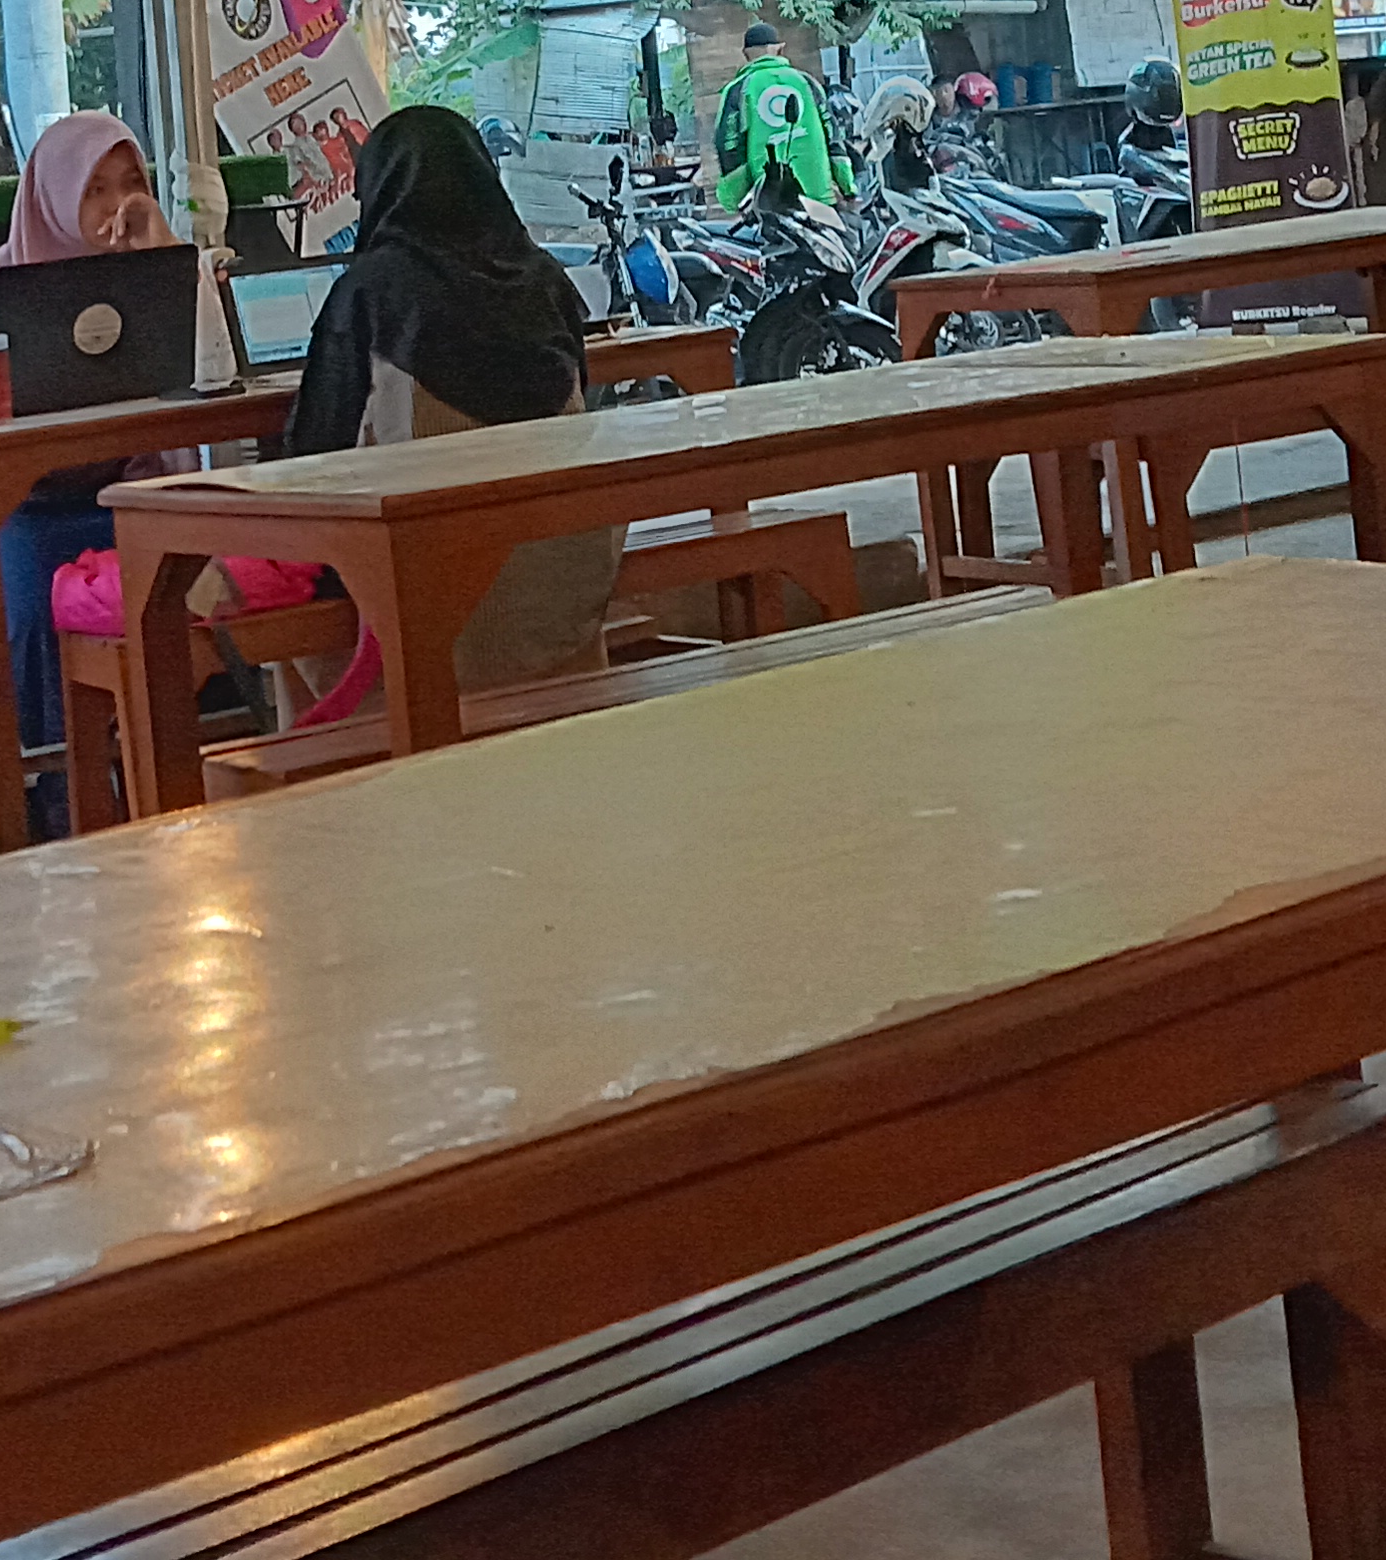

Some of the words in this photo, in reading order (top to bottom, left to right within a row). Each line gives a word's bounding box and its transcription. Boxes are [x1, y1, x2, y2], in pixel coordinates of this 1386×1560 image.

[213, 57, 260, 101] ICKET
[257, 7, 339, 72] AVAILABLE
[1187, 56, 1240, 80] GREEN
[1243, 51, 1276, 71] TEA
[264, 66, 312, 107] HERE
[1237, 119, 1295, 138] SECRET
[1242, 135, 1290, 153] MENU
[1200, 180, 1279, 206] SPAGHETTI
